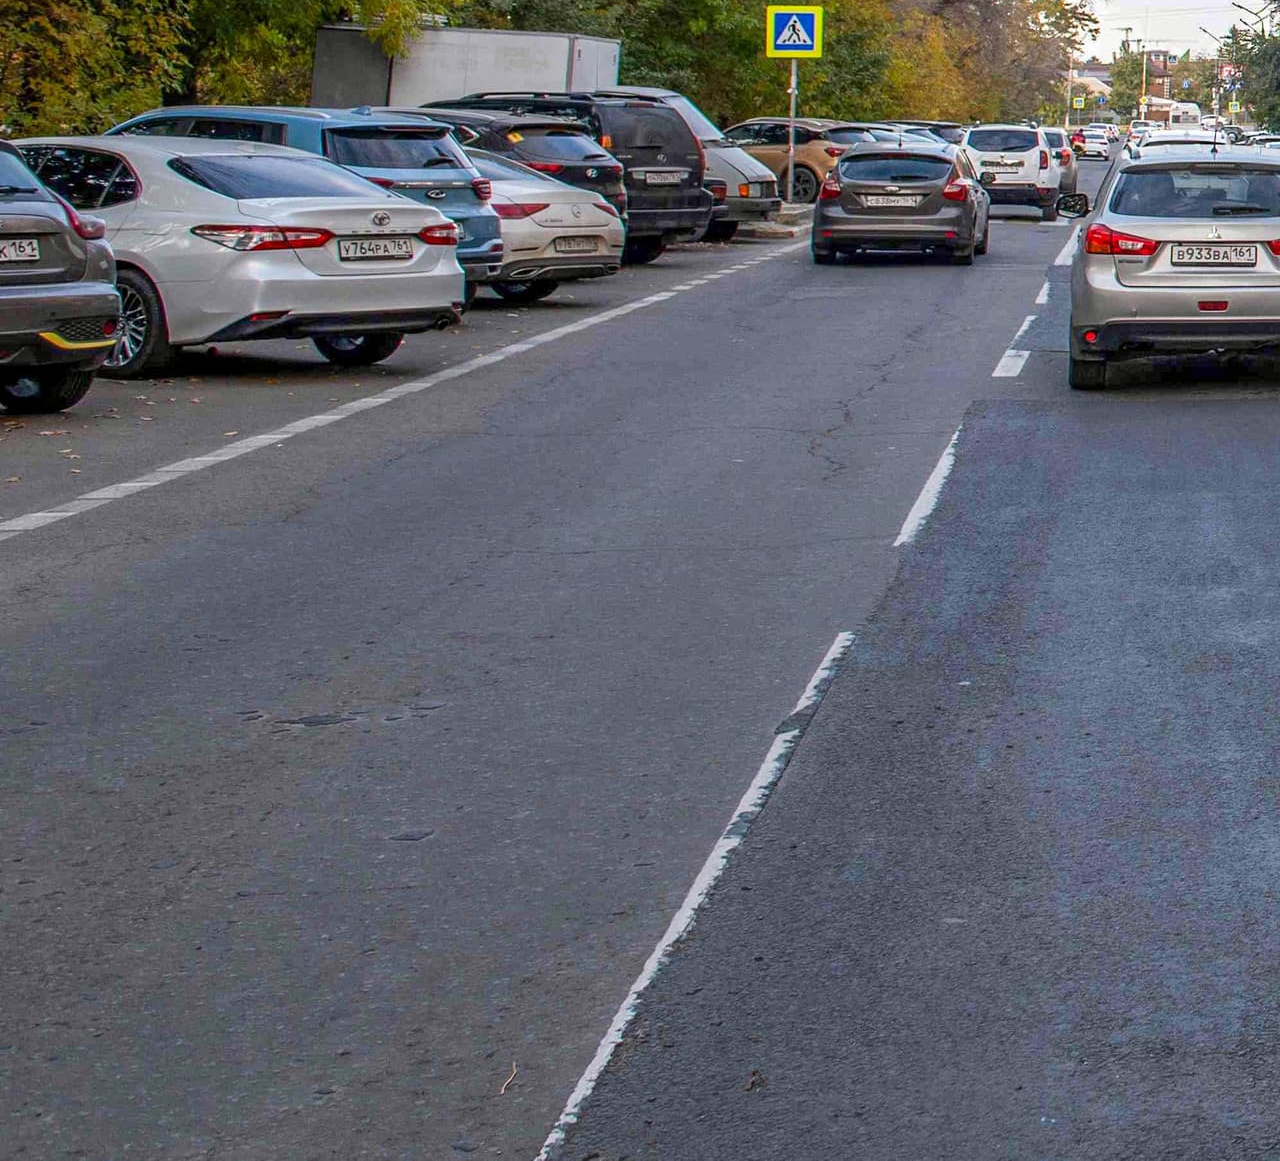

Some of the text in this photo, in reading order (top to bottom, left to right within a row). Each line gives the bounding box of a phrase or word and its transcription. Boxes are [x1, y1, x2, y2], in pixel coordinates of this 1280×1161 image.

[10, 241, 35, 253] 161
[343, 240, 409, 256] У764РА 761
[1177, 247, 1252, 261] В933ВА 161
